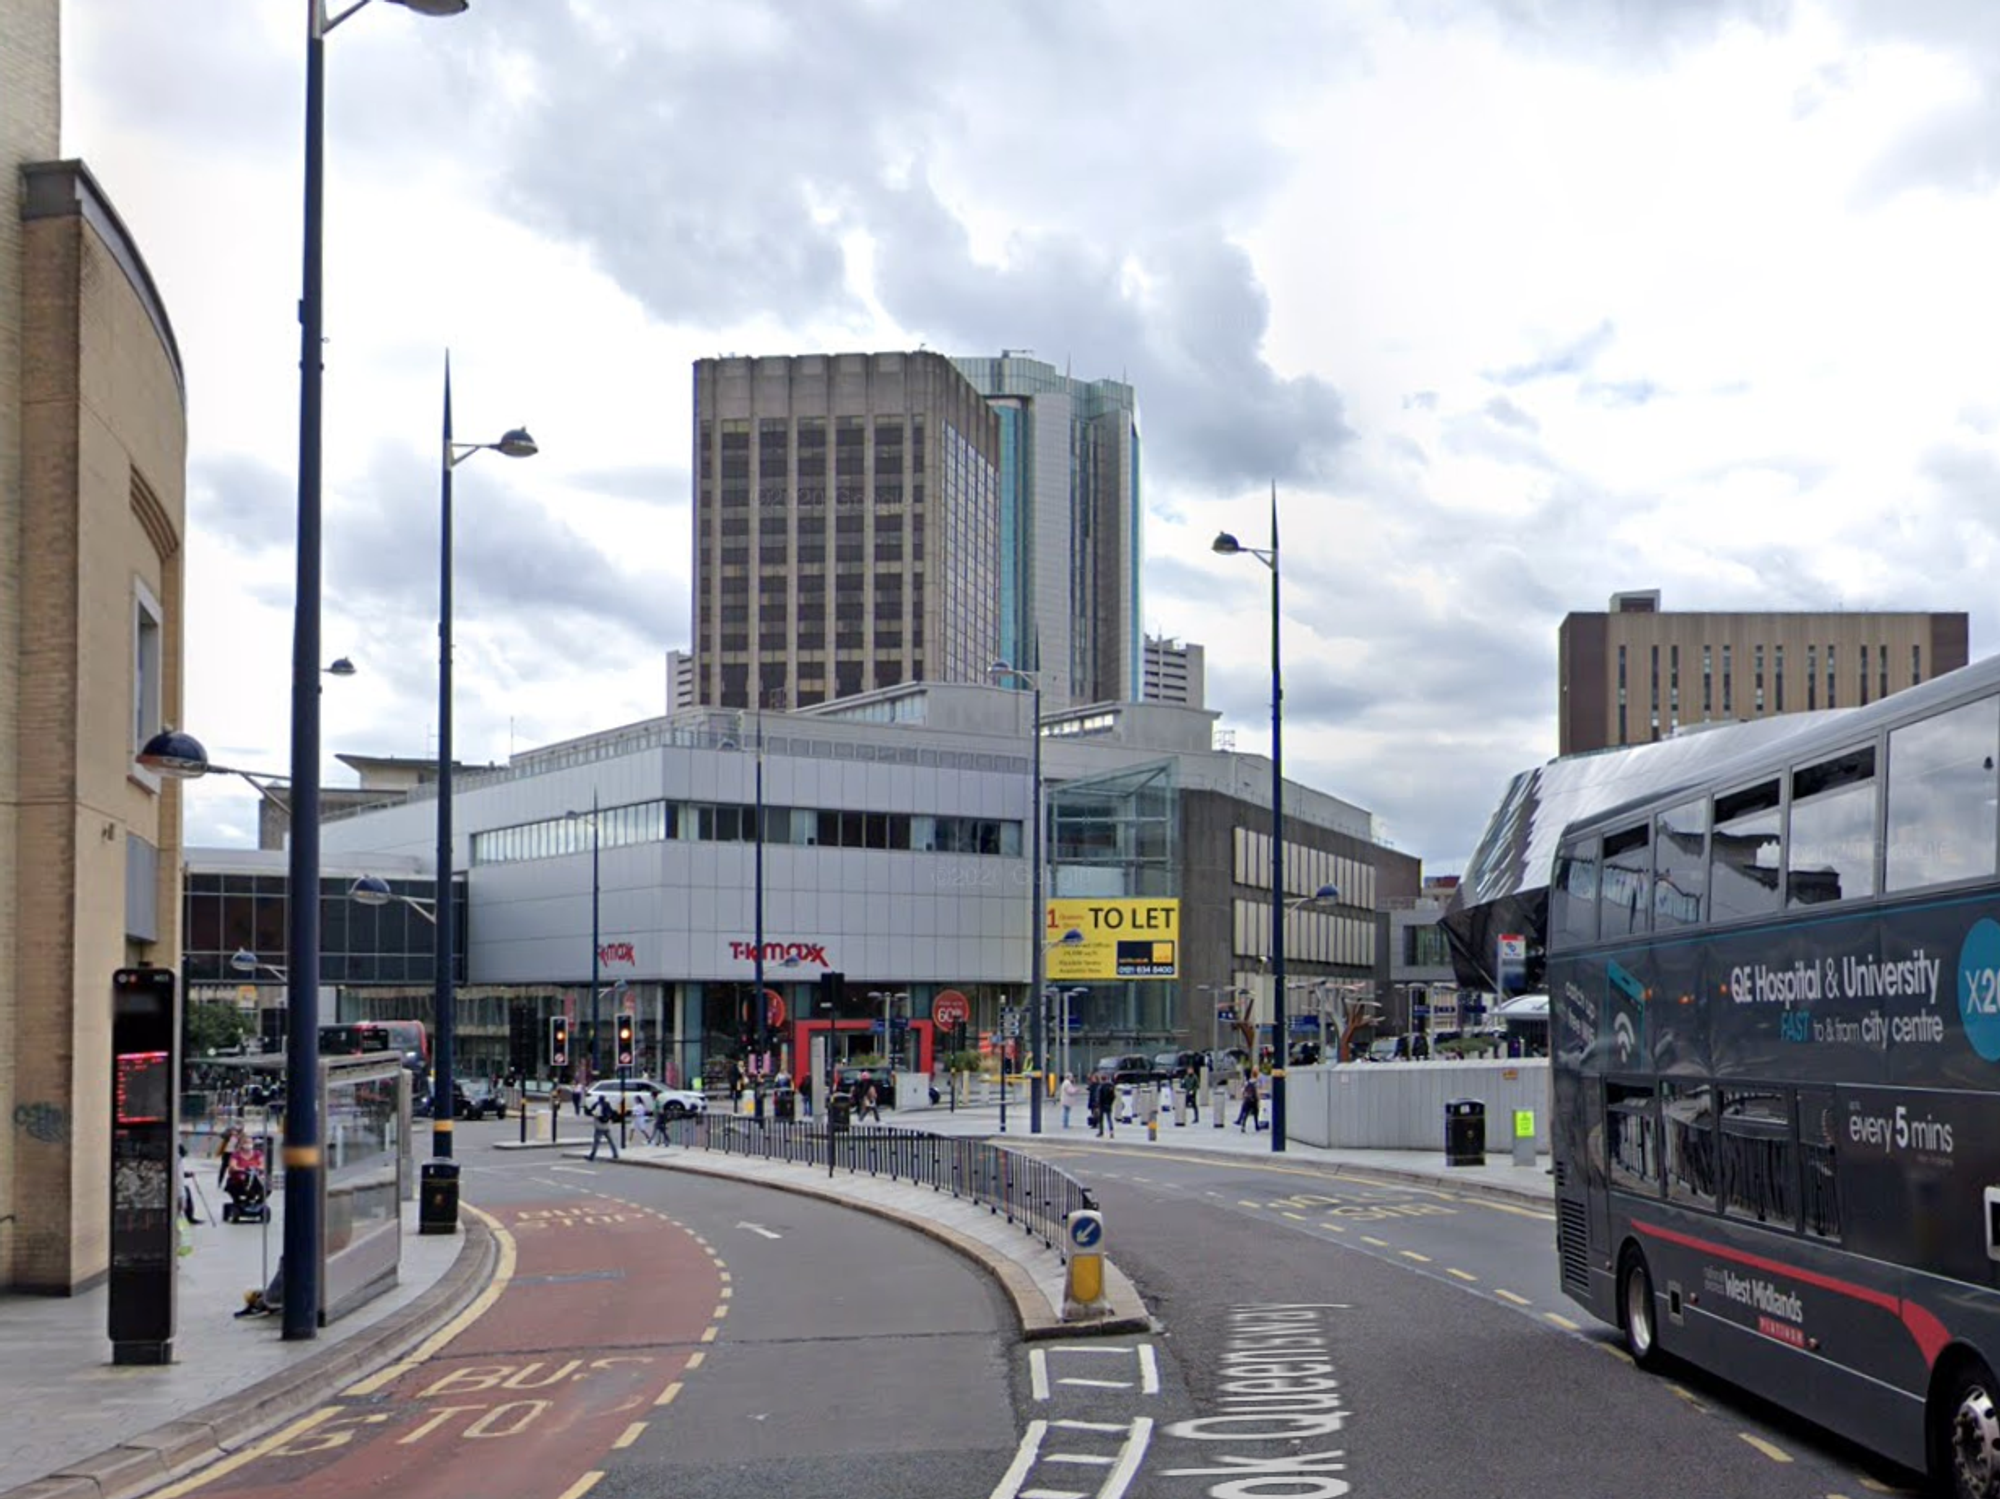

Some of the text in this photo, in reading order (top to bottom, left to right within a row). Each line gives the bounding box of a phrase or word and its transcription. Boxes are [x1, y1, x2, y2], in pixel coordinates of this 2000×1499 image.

[1047, 907, 1175, 929] 1 TO LET
[1731, 949, 1940, 1010] QE Hospital & University
[1965, 967, 2000, 1014] X2
[1781, 1011, 1810, 1042] FAST
[1813, 1019, 1824, 1042] to
[1835, 1017, 1859, 1042] from
[1862, 1008, 1888, 1051] city
[1892, 1007, 1944, 1043] centre
[1849, 1105, 1954, 1154] every 5 mins
[1723, 1269, 1752, 1306] West
[1752, 1278, 1803, 1323] Midlands
[1162, 1302, 1353, 1440] Queensway
[266, 1399, 645, 1457] STO
